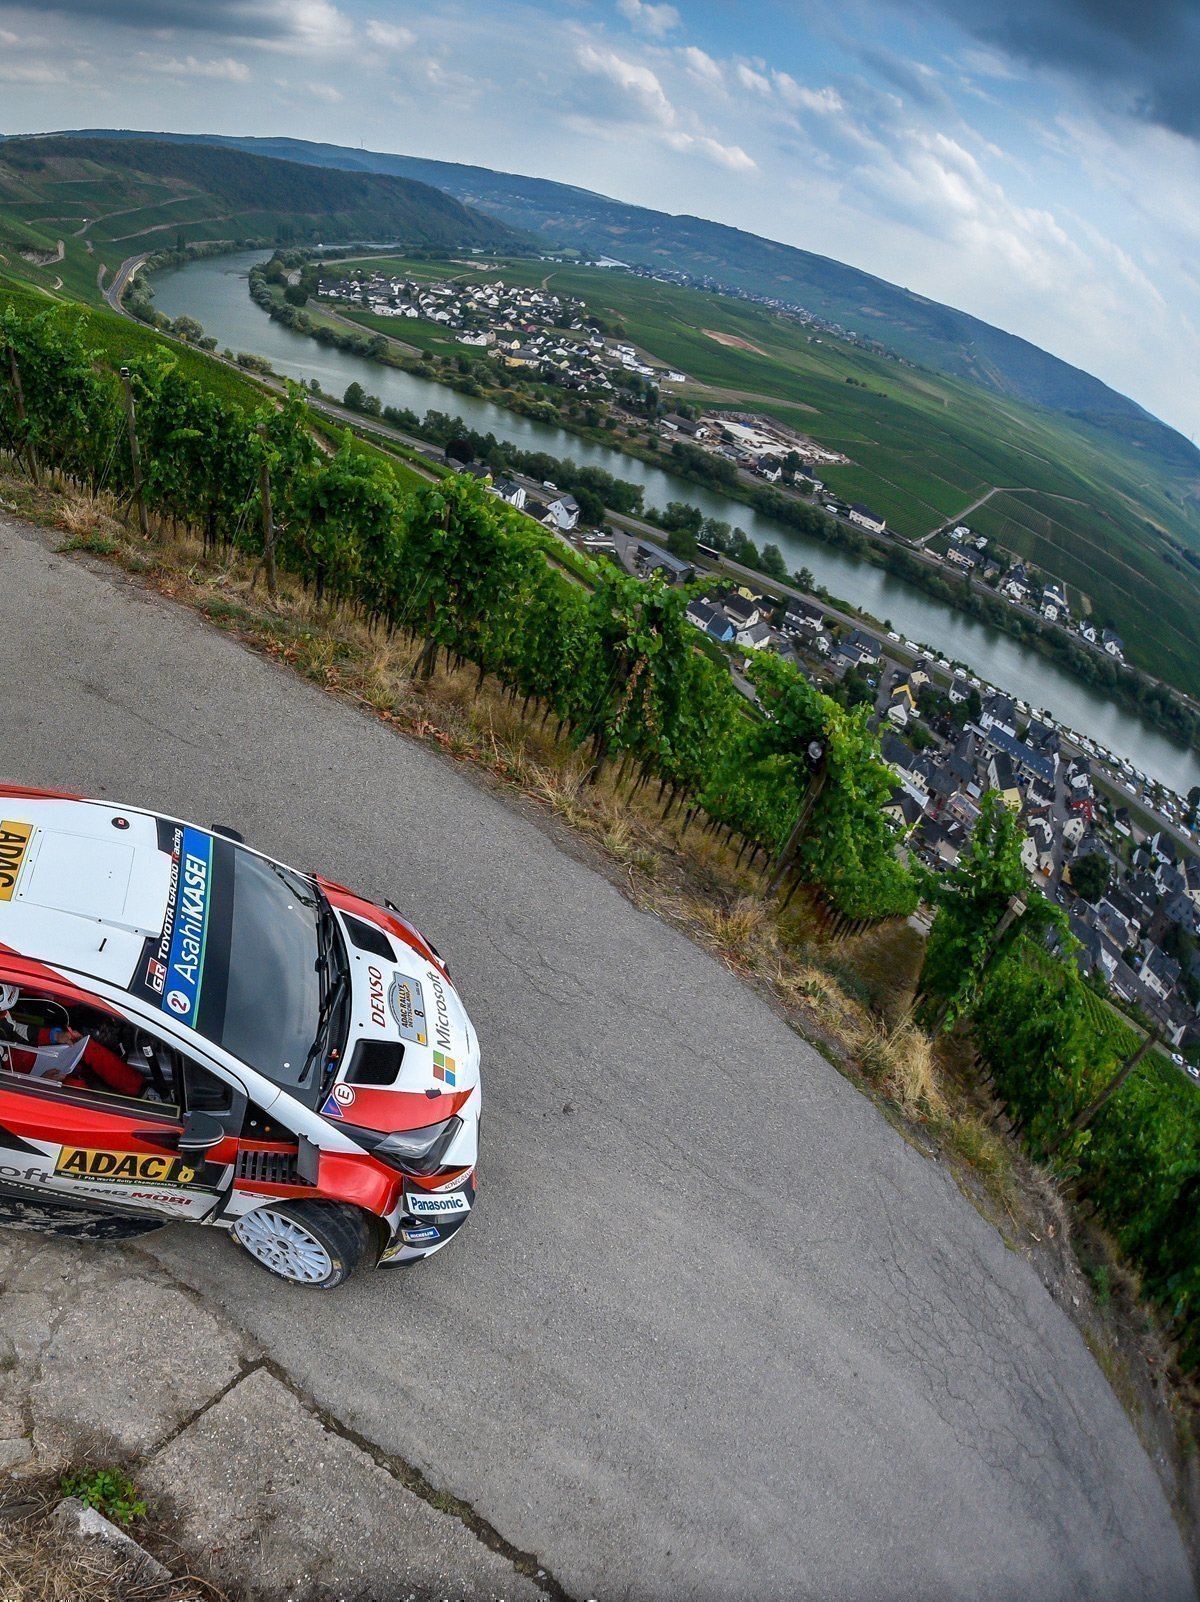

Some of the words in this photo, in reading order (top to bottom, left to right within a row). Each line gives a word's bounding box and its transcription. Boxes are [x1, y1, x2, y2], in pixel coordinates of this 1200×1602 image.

[171, 828, 184, 863] Racing
[167, 863, 179, 907] GAZOO
[158, 908, 175, 960] TOYOTA
[152, 962, 167, 991] GR
[368, 966, 386, 1028] DENSO
[398, 984, 408, 1008] RALLYE
[426, 971, 451, 1050] Microsoft
[400, 1010, 409, 1028] ADAC
[414, 1009, 424, 1018] 8
[338, 1088, 350, 1100] E
[62, 1150, 166, 1179] ADAC
[73, 1185, 128, 1196] DMG
[131, 1192, 193, 1206] MORI
[410, 1196, 464, 1211] Panasonic
